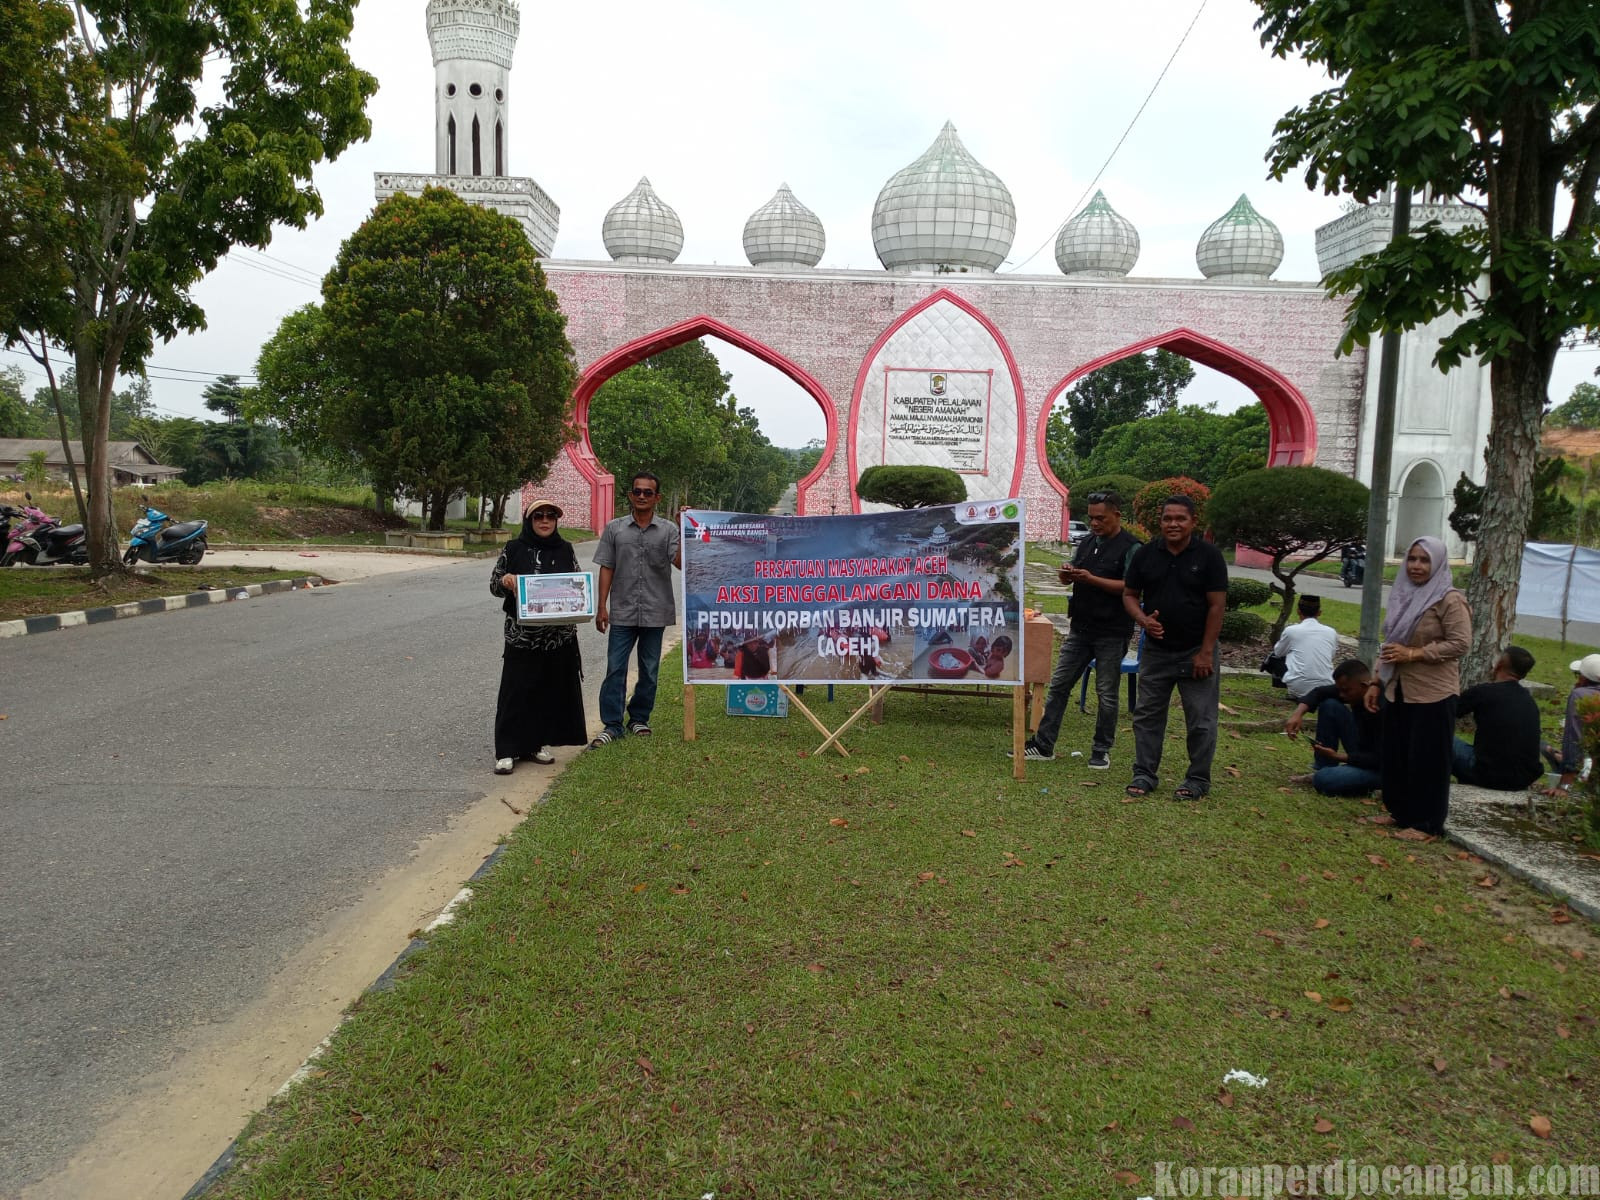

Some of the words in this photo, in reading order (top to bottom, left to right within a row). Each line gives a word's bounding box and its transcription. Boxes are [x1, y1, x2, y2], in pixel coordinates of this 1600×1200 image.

[893, 396, 937, 405] KABUPATEN
[938, 398, 982, 407] PELALAWAN
[755, 559, 824, 578] PERSATUAN
[828, 557, 912, 578] MASYARAKAT
[914, 556, 948, 575] ACEH
[716, 585, 760, 603] AKSI
[765, 582, 921, 603] PENGGALANGAN
[927, 581, 983, 601] DANA
[697, 610, 759, 630] PEDULI
[762, 609, 835, 630] KORBAN
[838, 608, 903, 629] BANJIR
[908, 606, 1006, 628] SUMATERA
[817, 634, 880, 658] (ACEH)
